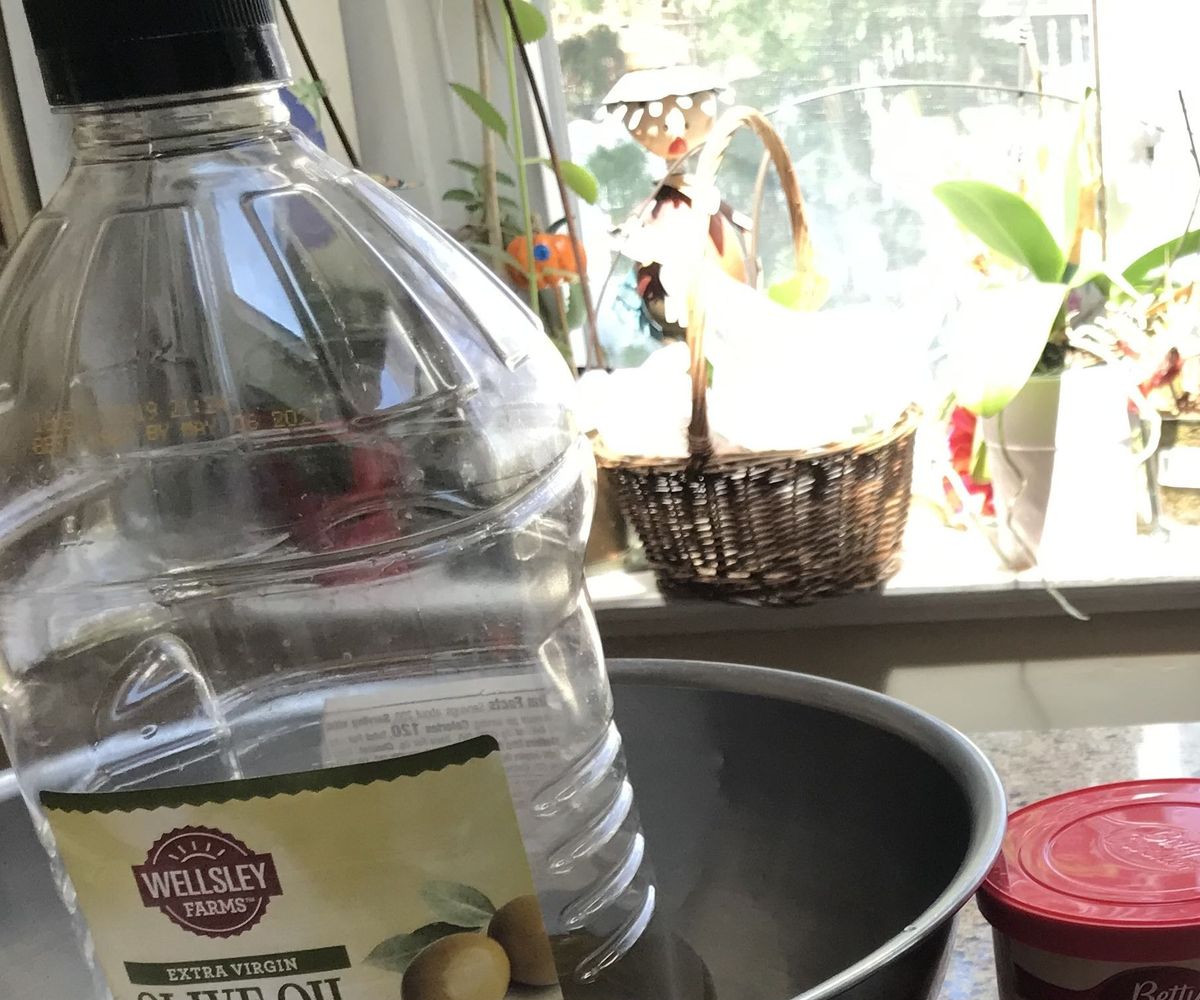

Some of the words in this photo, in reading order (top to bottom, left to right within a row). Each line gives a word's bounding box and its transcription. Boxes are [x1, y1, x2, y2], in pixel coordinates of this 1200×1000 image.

[141, 862, 267, 899] WELLSLEY
[183, 897, 248, 917] FARMS
[166, 963, 229, 982] EXTRA
[230, 957, 298, 977] VIRGIN
